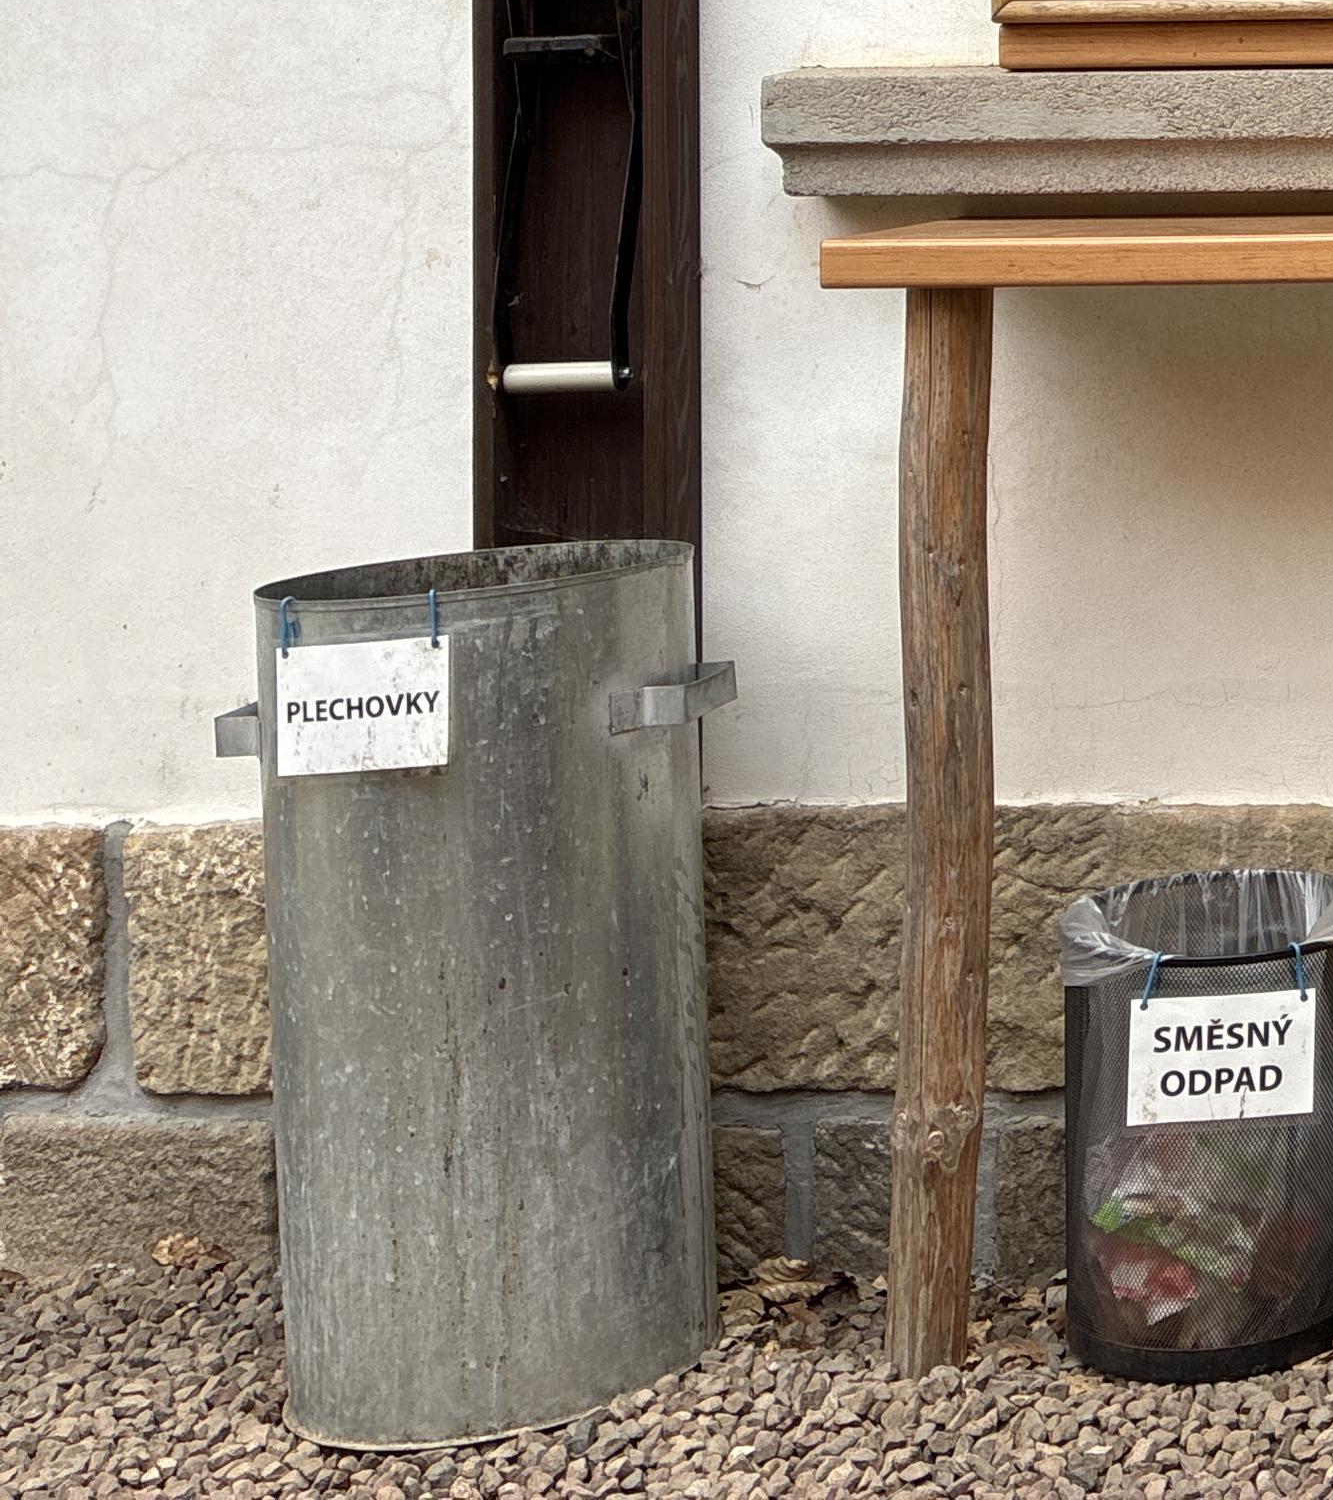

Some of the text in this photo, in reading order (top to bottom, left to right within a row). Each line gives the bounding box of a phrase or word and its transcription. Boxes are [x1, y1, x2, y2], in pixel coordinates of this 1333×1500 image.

[287, 690, 440, 724] PLECHOVKY
[1153, 1013, 1293, 1055] SMĚSNÝ
[1160, 1064, 1283, 1098] ODPAD
